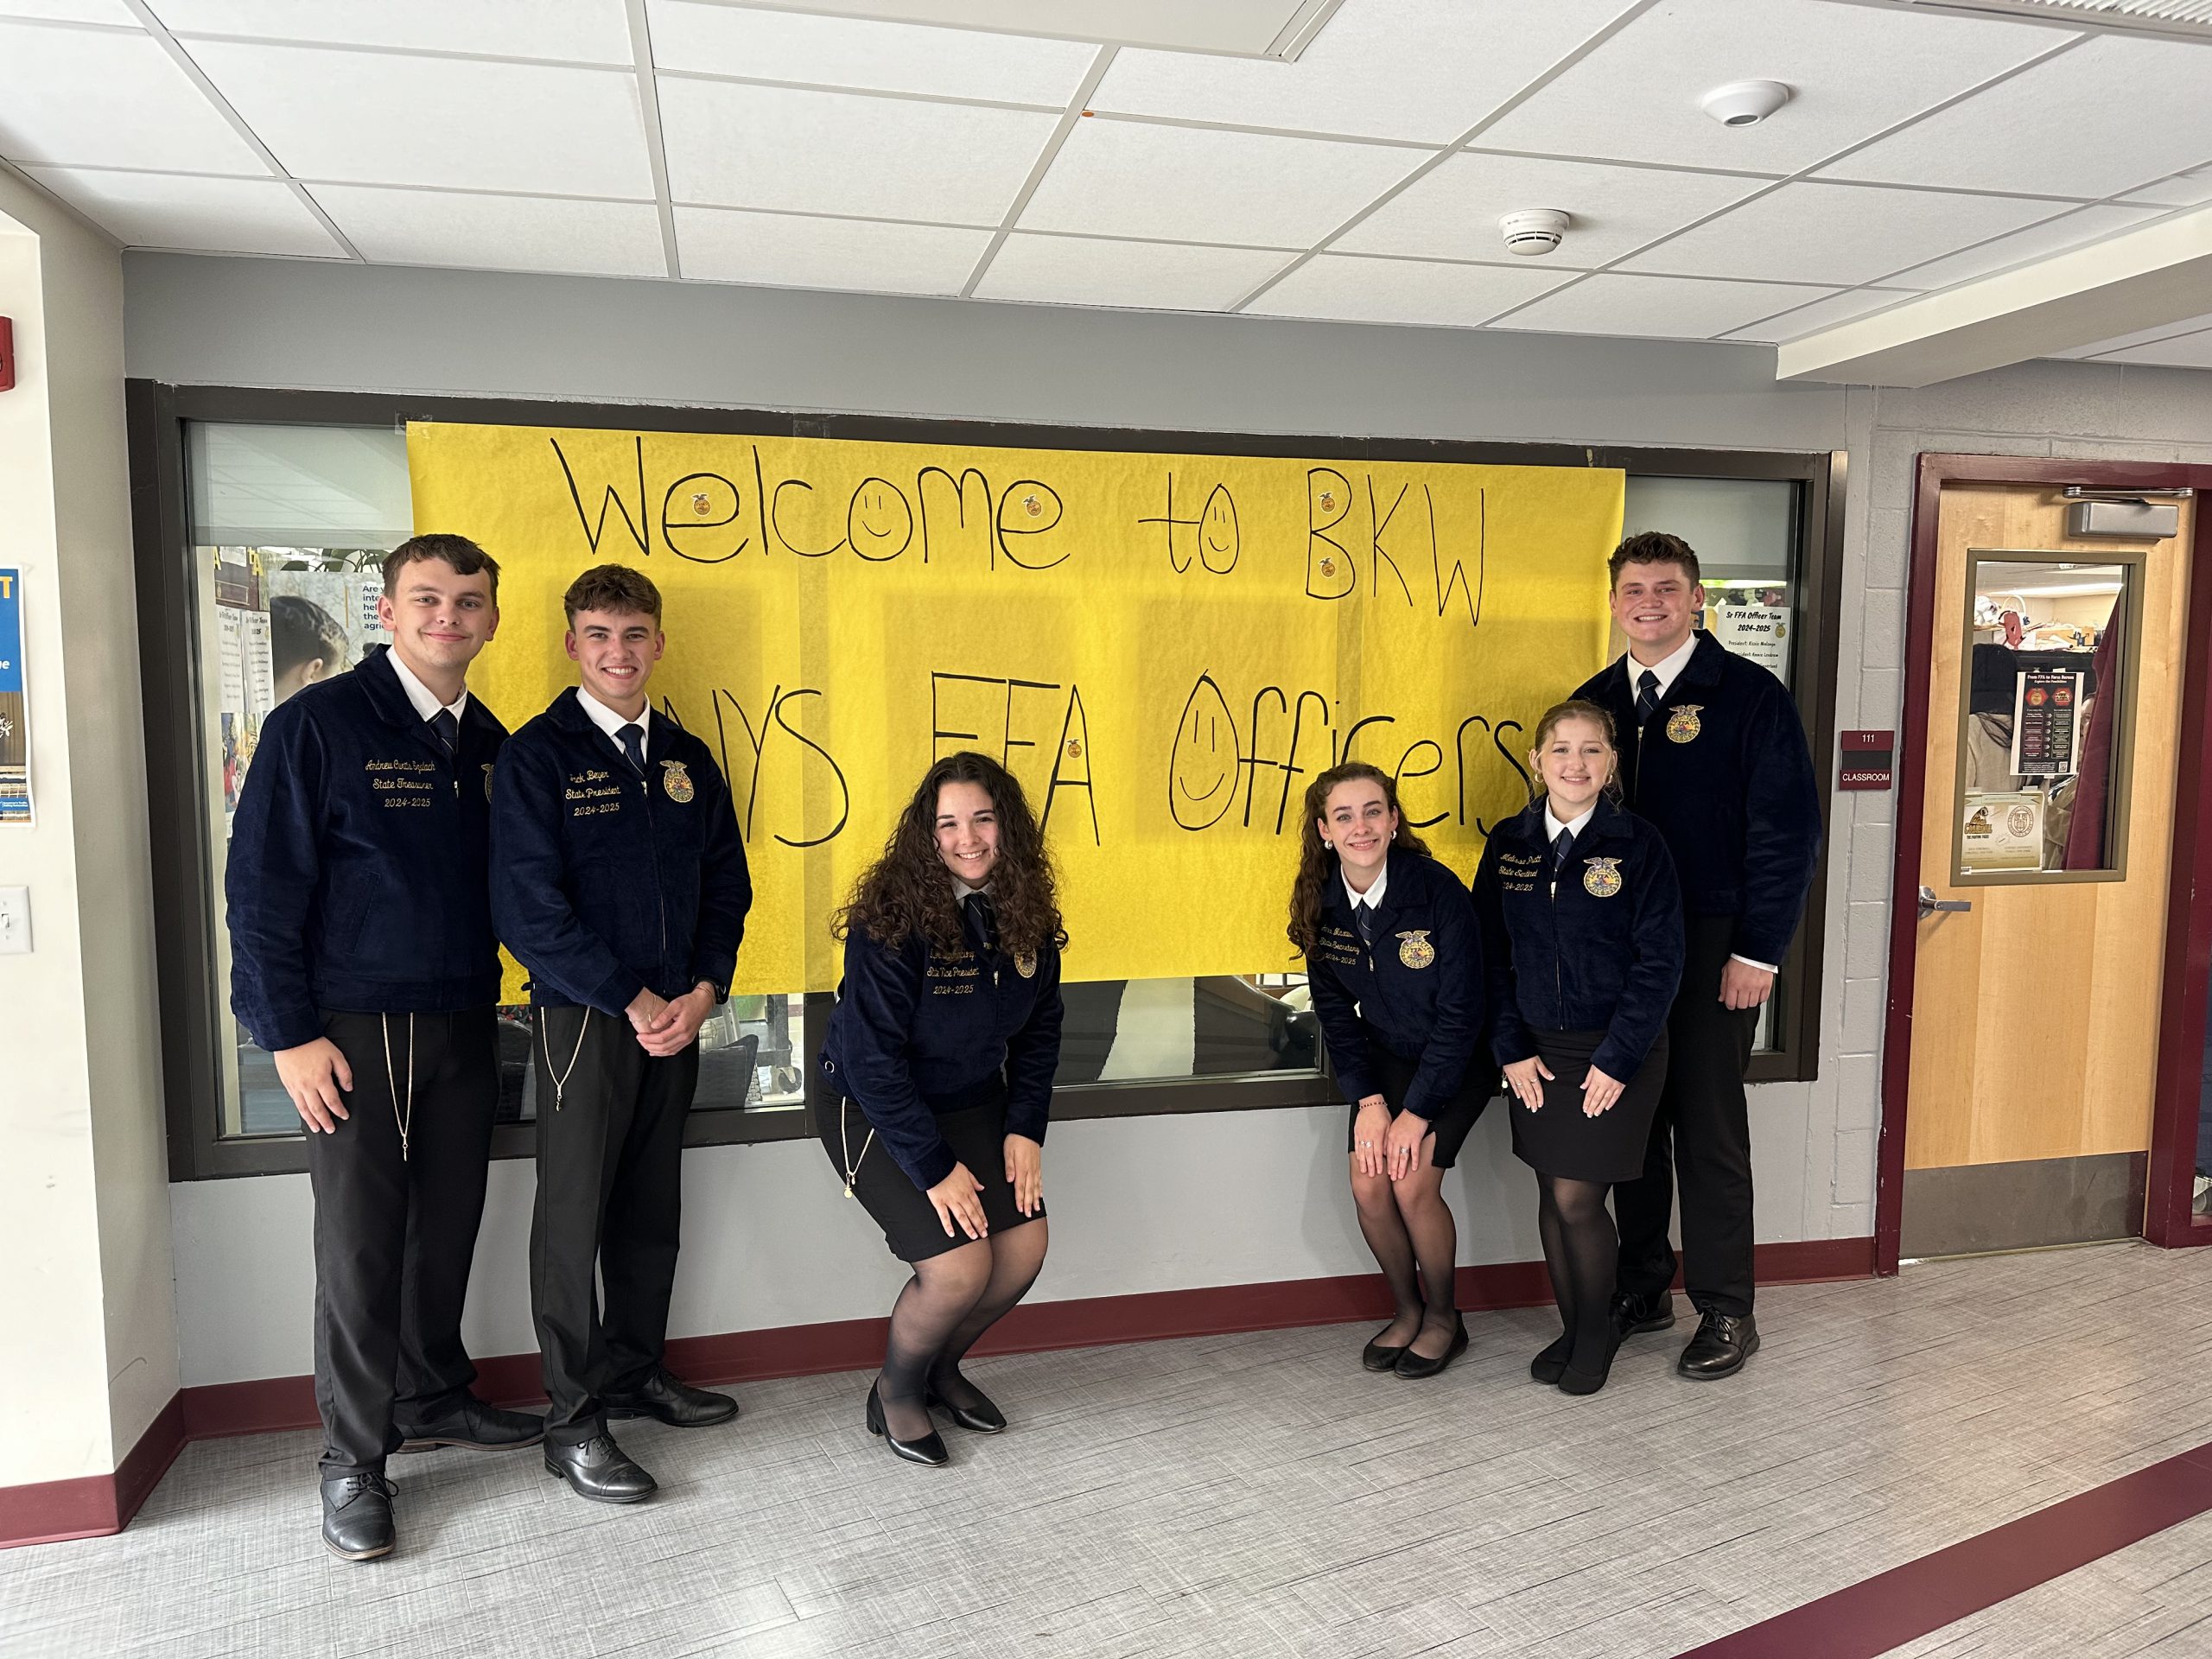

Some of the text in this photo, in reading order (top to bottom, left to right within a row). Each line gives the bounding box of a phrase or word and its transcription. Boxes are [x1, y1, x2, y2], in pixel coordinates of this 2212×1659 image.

[550, 435, 1485, 627] Welcome to BKW
[1747, 611, 1768, 620] Officer
[1769, 612, 1782, 620] Team
[663, 668, 1532, 848] NYS FFA Officers
[365, 759, 393, 771] Andrew
[372, 778, 434, 790] State Treasurer
[565, 785, 621, 800] State President
[385, 798, 431, 808] 2024-2025
[573, 802, 620, 817] 2024-2025
[1498, 865, 1515, 876] State
[1332, 940, 1360, 956] Secretary
[932, 984, 975, 995] 2024-2025
